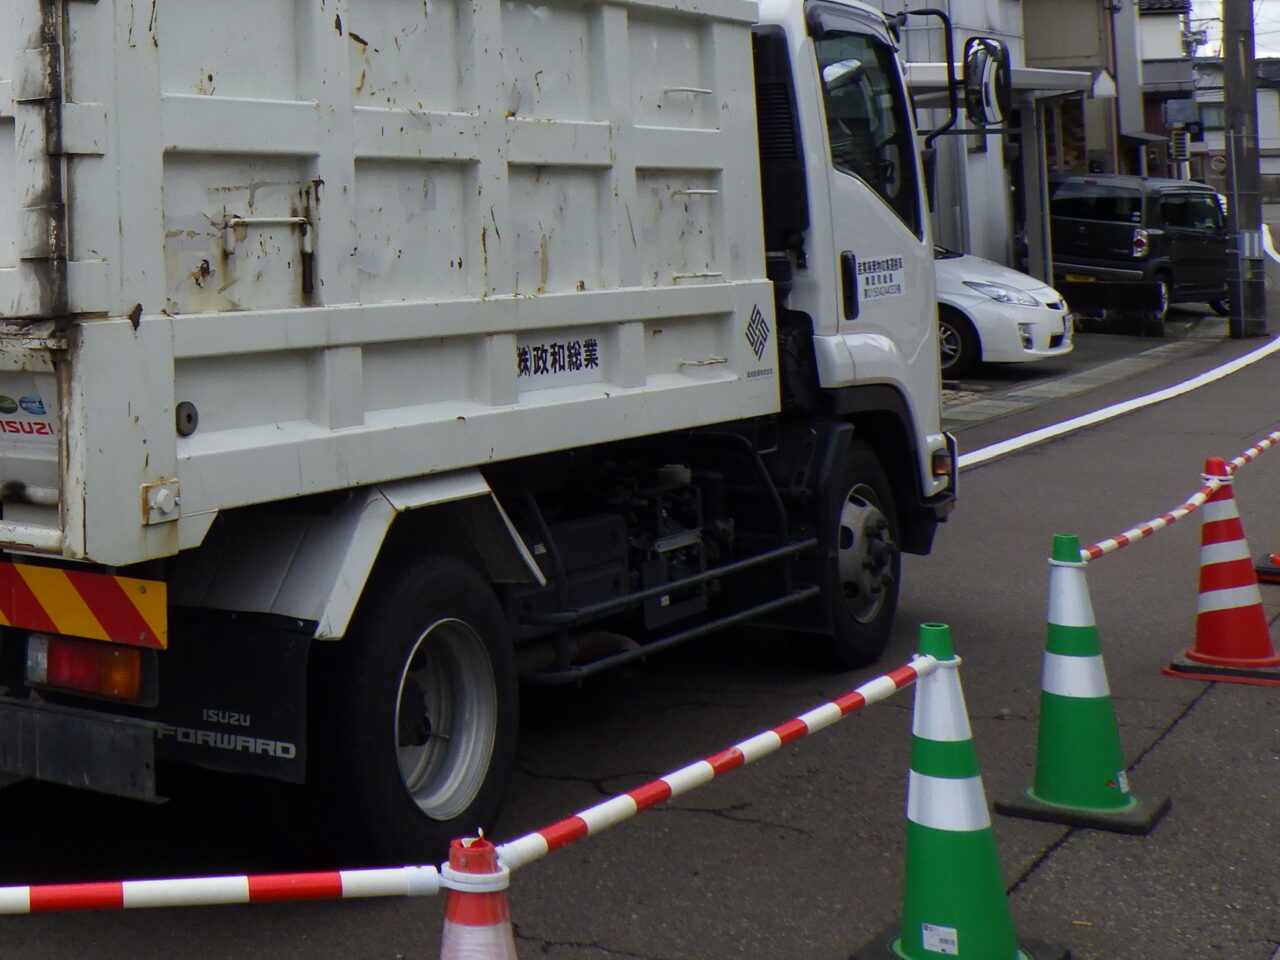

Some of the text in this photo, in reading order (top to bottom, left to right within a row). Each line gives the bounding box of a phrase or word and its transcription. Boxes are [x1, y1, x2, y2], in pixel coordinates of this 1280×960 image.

[517, 338, 599, 378] 株)政和総業
[203, 708, 251, 727] ISUZU
[157, 726, 296, 759] FORWARD
